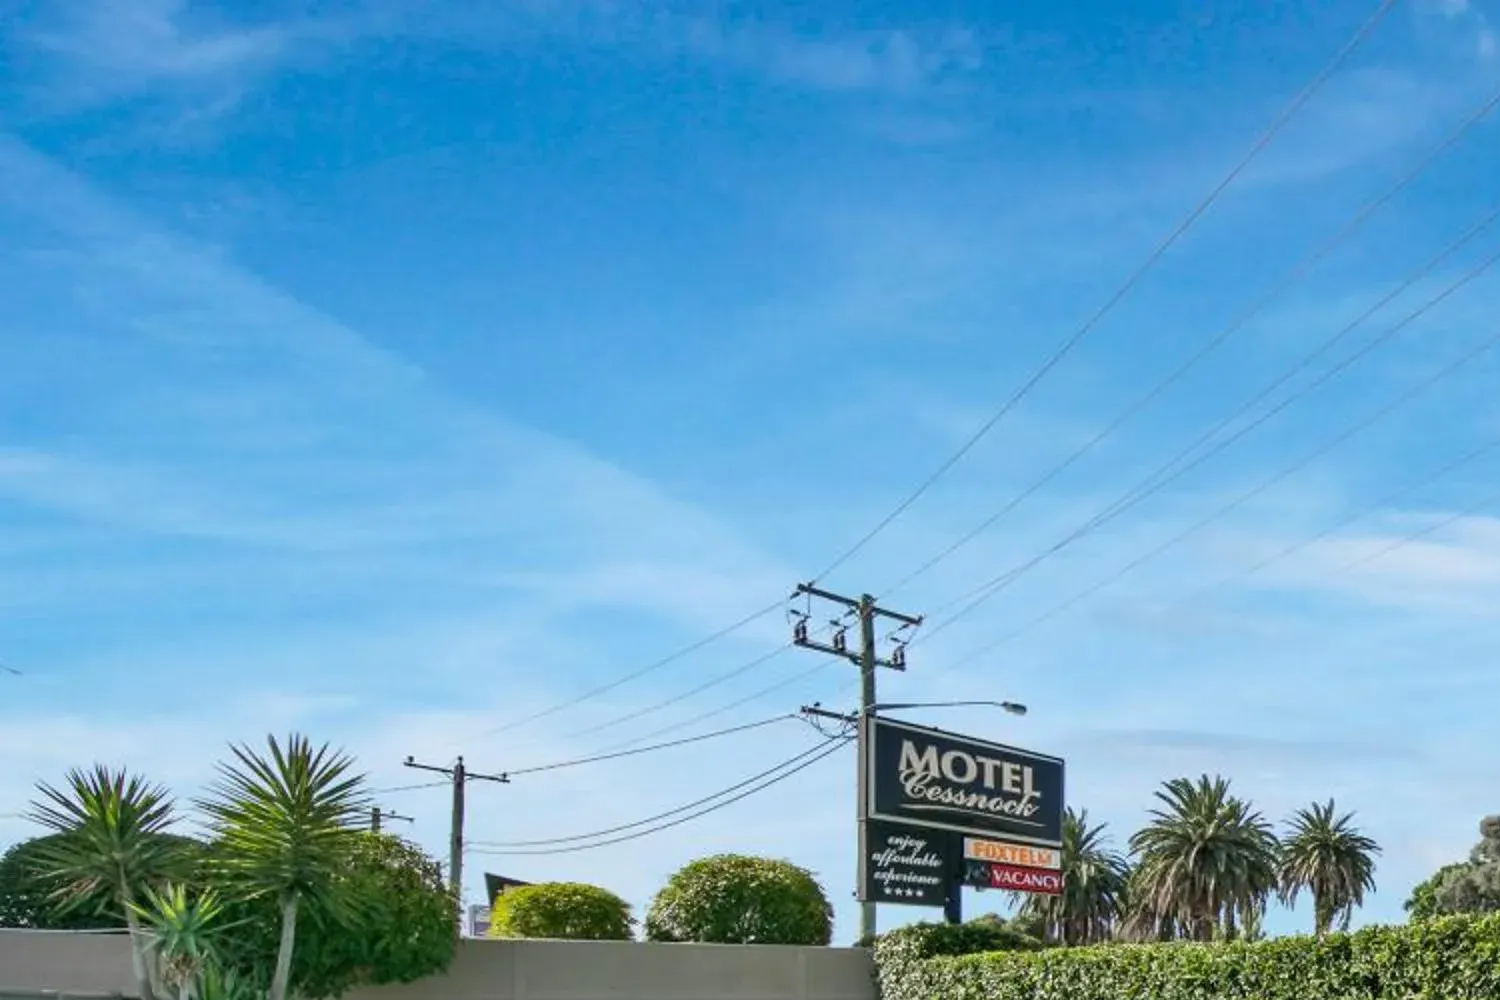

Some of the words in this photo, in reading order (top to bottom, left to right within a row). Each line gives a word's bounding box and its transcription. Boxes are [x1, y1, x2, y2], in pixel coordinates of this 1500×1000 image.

[898, 739, 1041, 798] MOTEL
[899, 768, 1040, 817] Cessnock
[887, 835, 928, 853] enjoy
[871, 847, 943, 868] affordable
[873, 868, 941, 885] experience
[993, 869, 1060, 888] VACANCY
